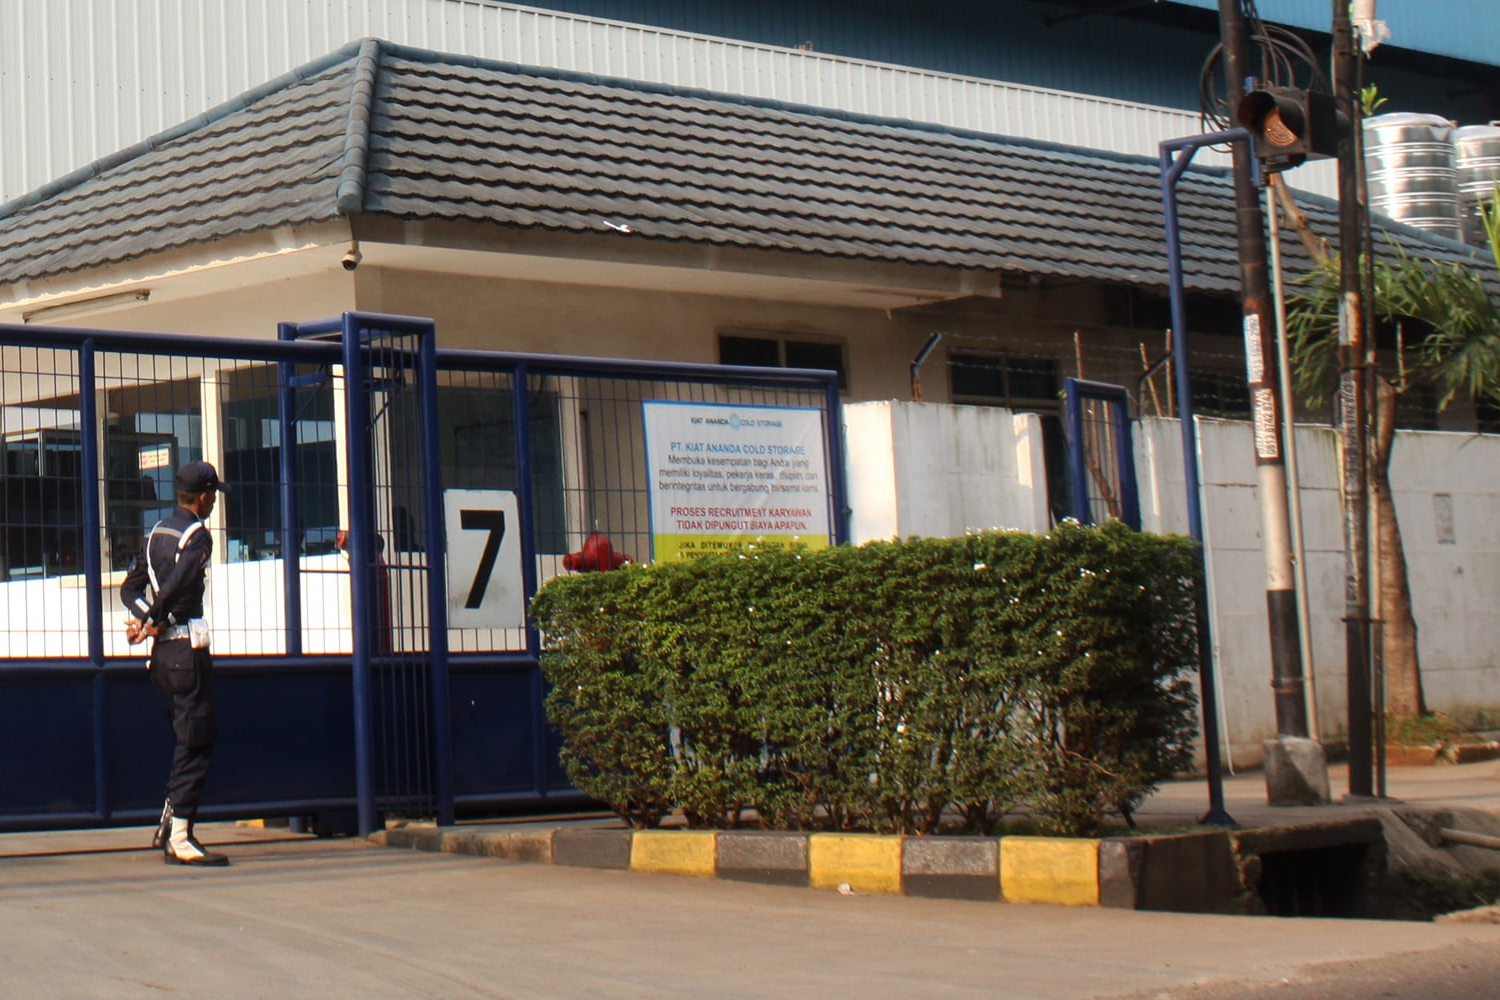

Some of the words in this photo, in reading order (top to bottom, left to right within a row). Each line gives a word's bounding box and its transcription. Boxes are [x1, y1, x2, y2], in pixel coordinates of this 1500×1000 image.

[691, 416, 702, 424] KIAT
[740, 419, 755, 427] COLD
[685, 443, 704, 452] KIAT
[707, 444, 741, 453] ANANDA
[743, 445, 766, 454] COLD
[767, 446, 805, 456] STORAGE
[668, 454, 706, 465] Membuka
[707, 456, 752, 468] kesempatan
[753, 458, 769, 470] bagi
[770, 458, 790, 468] Anda
[791, 459, 810, 471] yang
[659, 468, 691, 478] memiliki
[726, 470, 754, 481] pekerja
[659, 480, 706, 493] berintegritas
[707, 481, 729, 492] untuk
[730, 483, 770, 495] bergabung
[771, 484, 801, 493] bersama
[670, 507, 706, 517] PROSES
[708, 507, 766, 518] RECRUITMENT
[769, 508, 812, 518] KARYAWAN
[676, 519, 703, 530] TIDAK
[705, 520, 749, 531] DIPUNGUT
[750, 521, 773, 531] BIAYA
[678, 541, 696, 549] JIKA
[460, 510, 506, 609] 7
